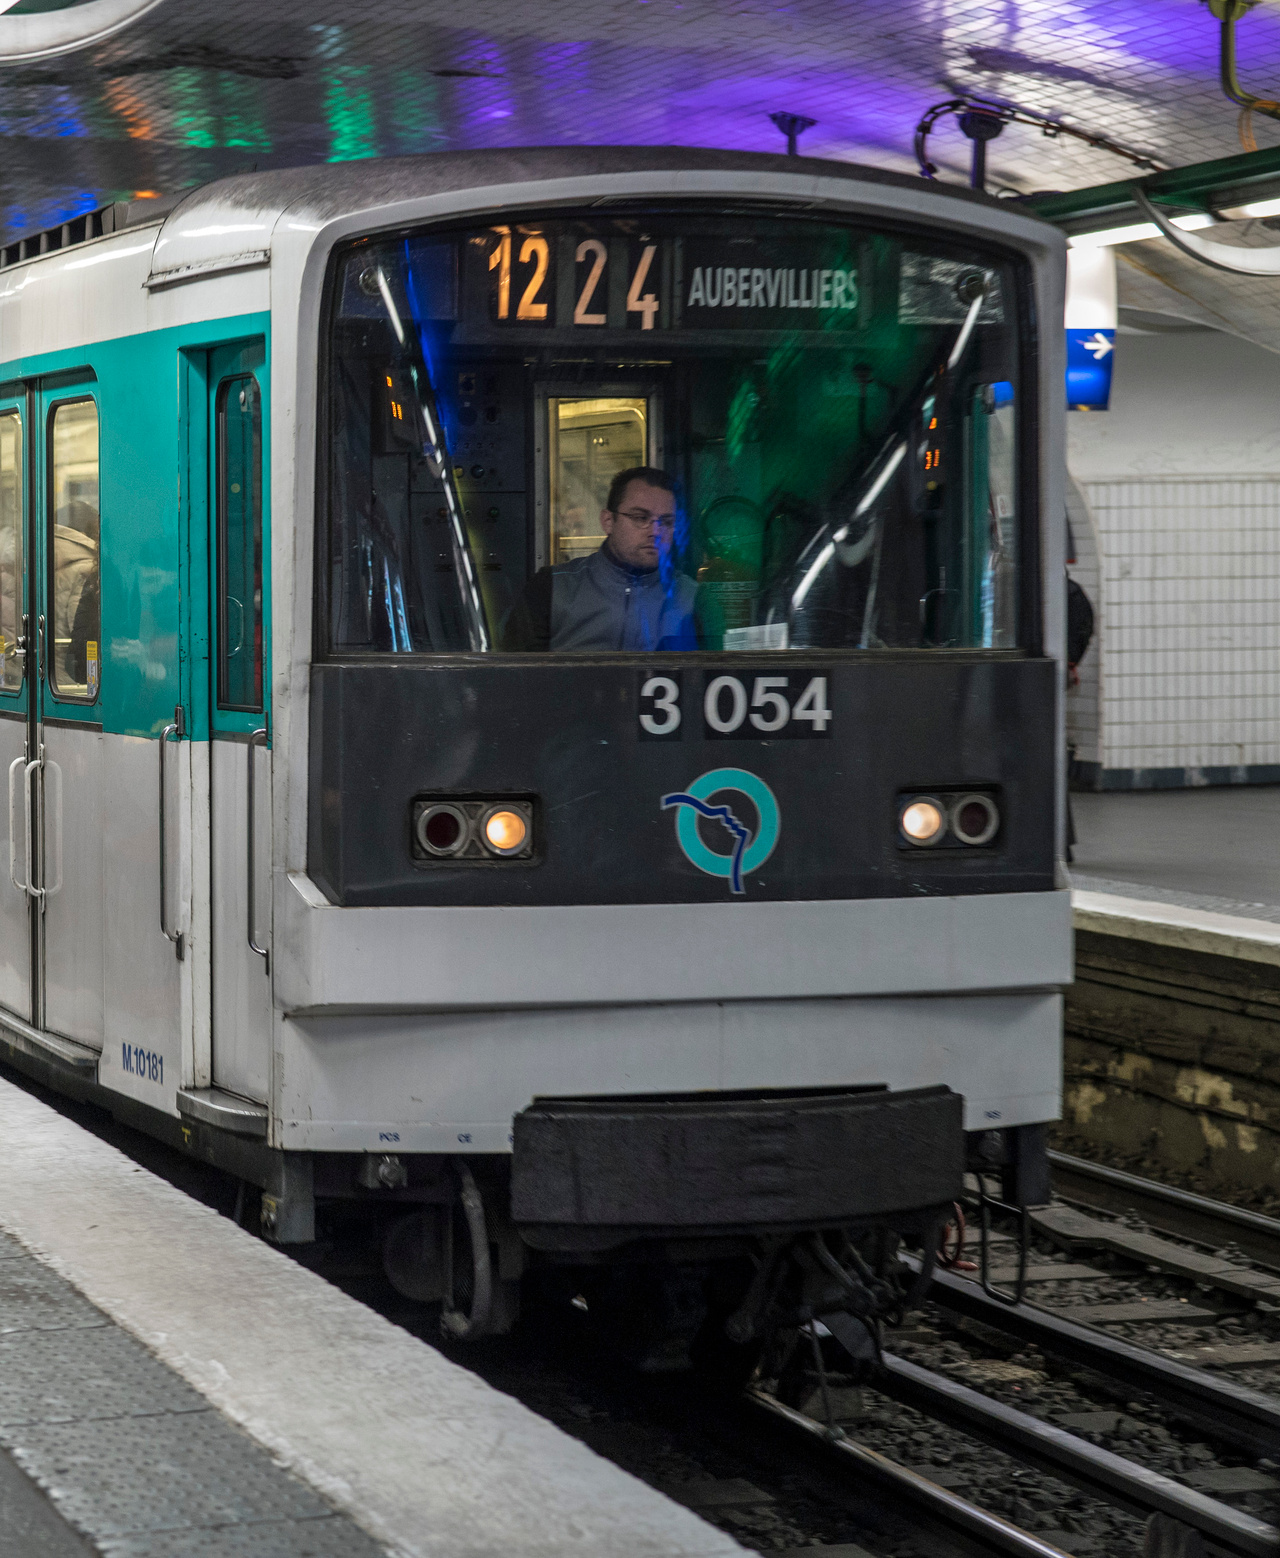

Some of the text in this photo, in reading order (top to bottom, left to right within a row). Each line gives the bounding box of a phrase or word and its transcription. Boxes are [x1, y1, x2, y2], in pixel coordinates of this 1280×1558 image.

[488, 233, 858, 330] 12 2 4 AUBERVILLIERS
[639, 676, 832, 735] 3 054
[122, 1042, 163, 1084] M.10181
